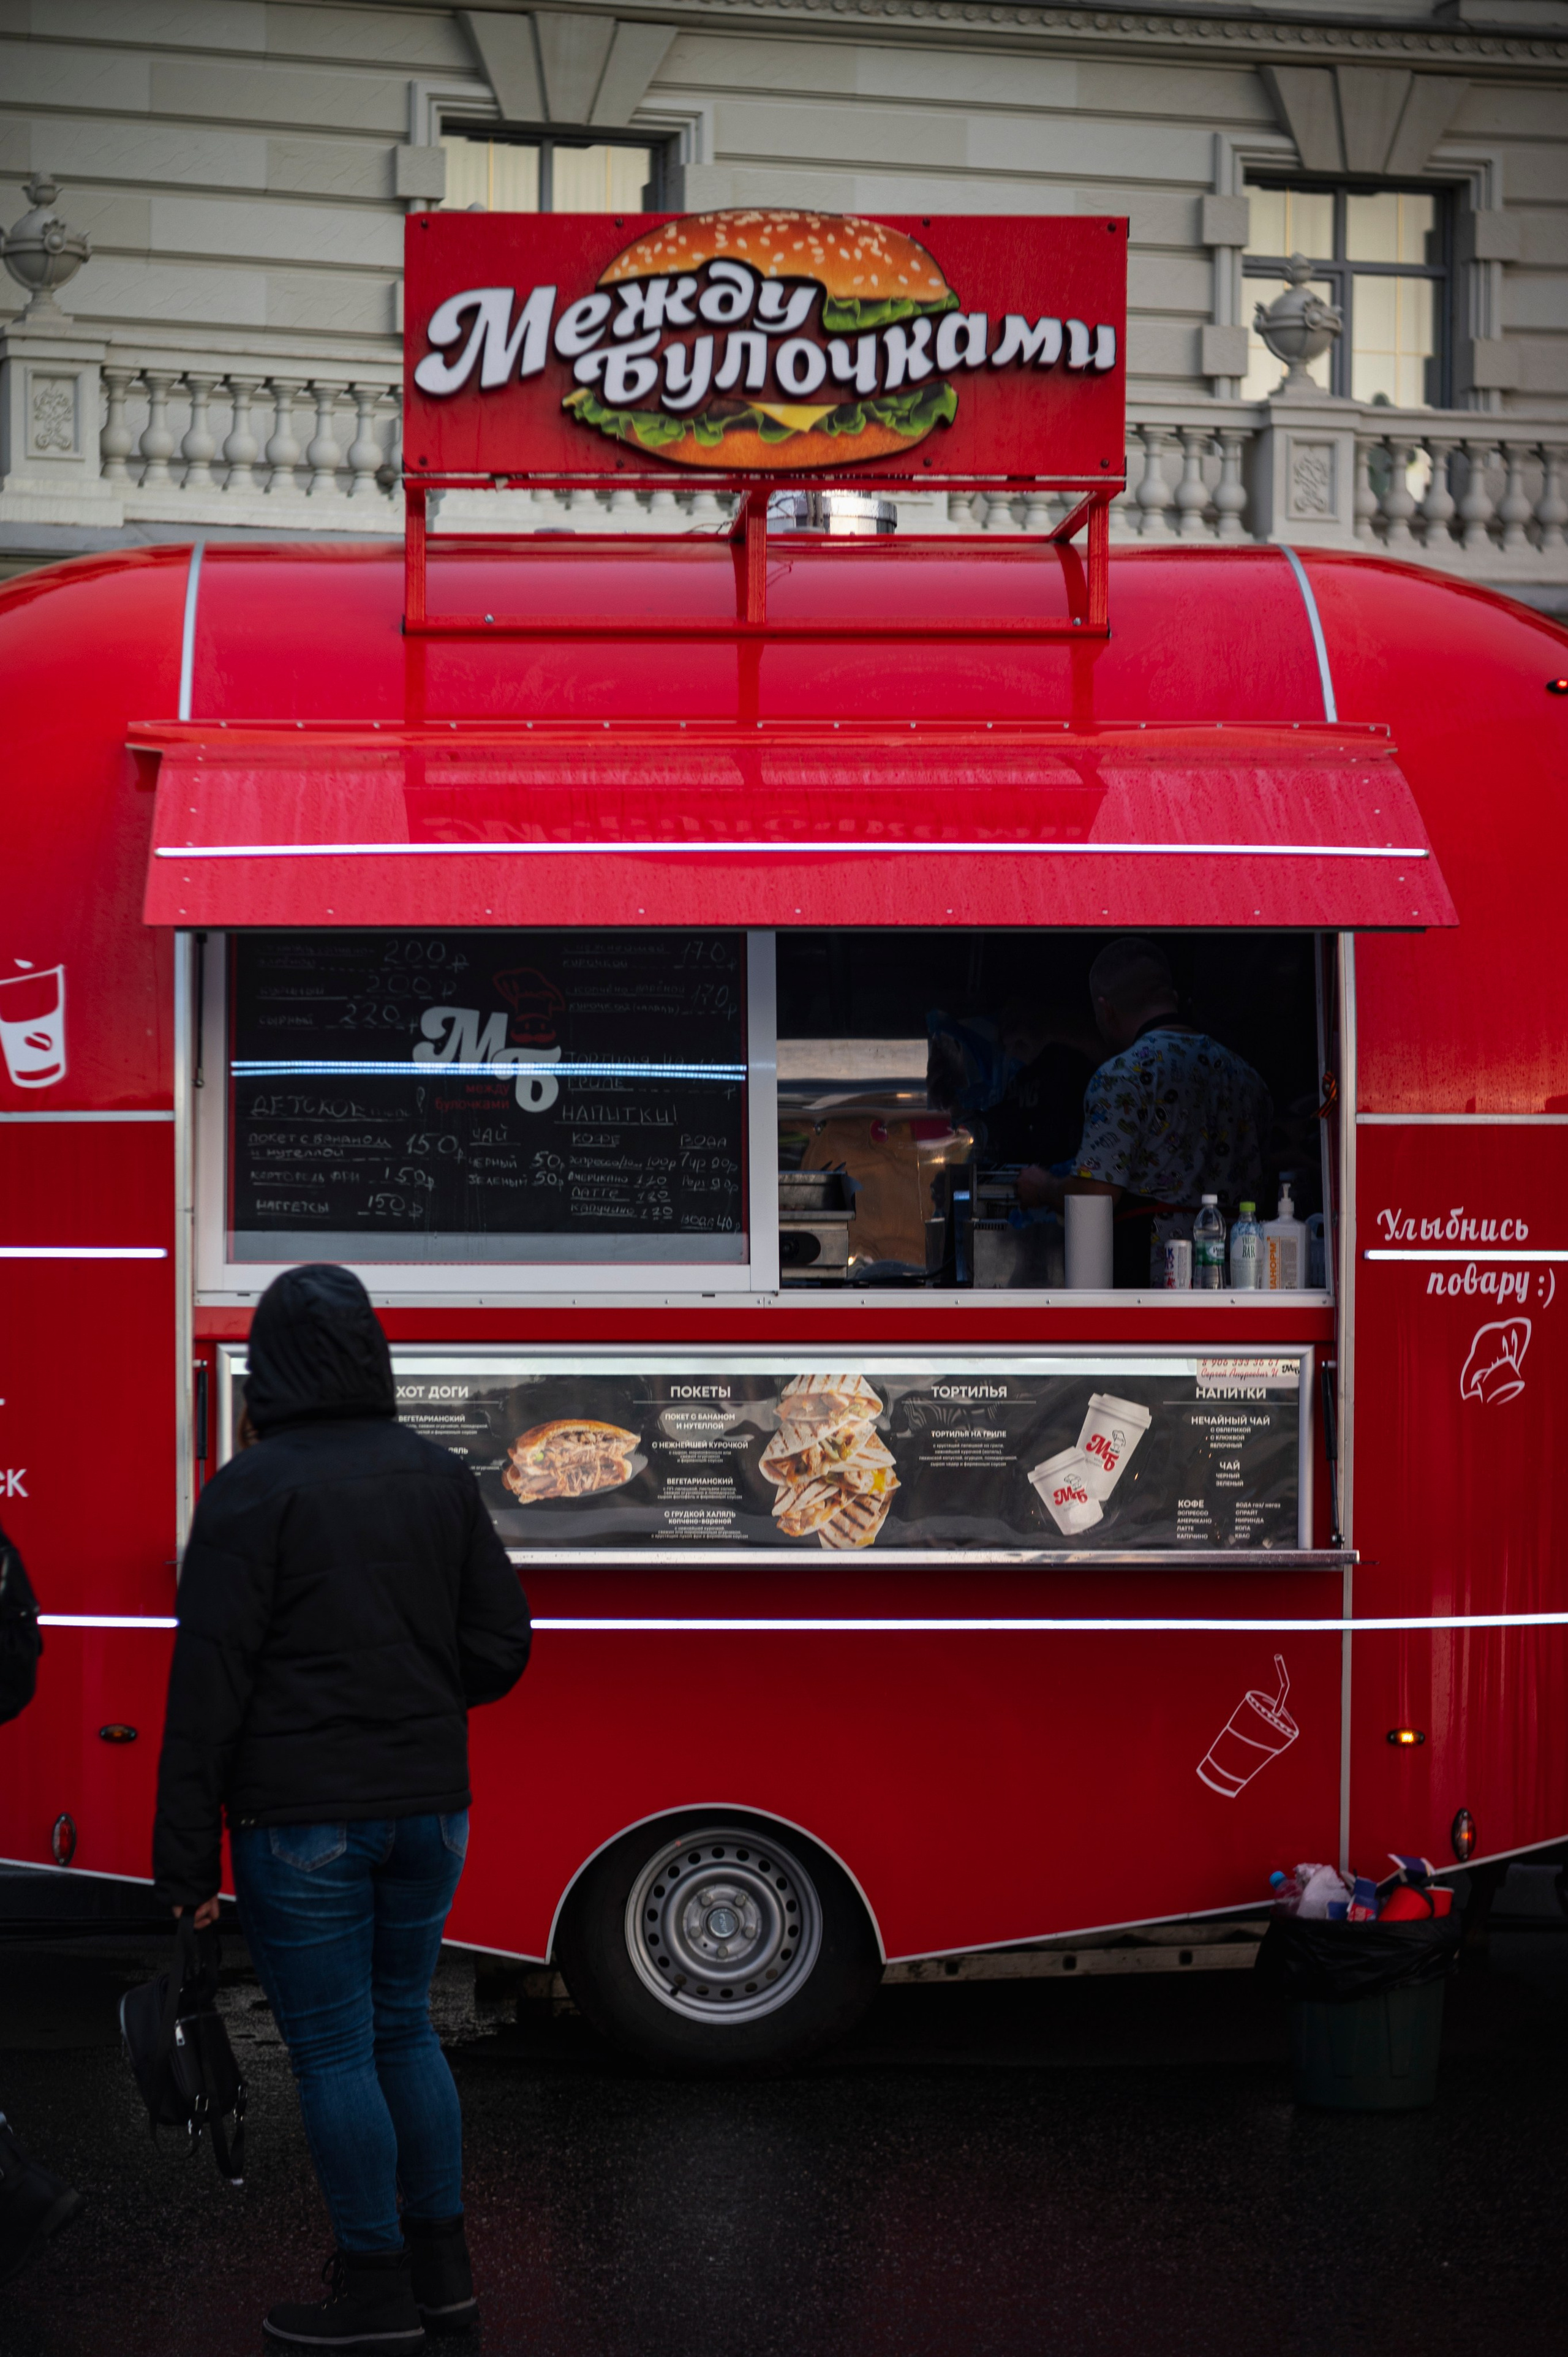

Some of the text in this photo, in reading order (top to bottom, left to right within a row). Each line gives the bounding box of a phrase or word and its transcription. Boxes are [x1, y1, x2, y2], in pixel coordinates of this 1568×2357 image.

[413, 258, 818, 398] Между
[1376, 1205, 1529, 1242] Улыбнись
[1426, 1261, 1531, 1306] повару
[396, 1386, 469, 1400] ХОТ ДОГИ
[671, 1385, 731, 1398] ПОКЕТЫ
[931, 1386, 1008, 1398] ТОРТИЛЬЯ
[1196, 1386, 1267, 1399] НАПИТКИ
[398, 1414, 466, 1423] ВЕГЕТАРИАНСКИЙ
[1191, 1414, 1271, 1426] НЕЧАЙНЫЙ ЧАЙ
[684, 1420, 725, 1430] НУТЕЛЛОЙ
[659, 1439, 707, 1449] НЕЖНЕЙШЕЙ
[709, 1440, 748, 1449] КУРОЧКОЙ
[1219, 1459, 1241, 1471] ЧАЙ
[667, 1476, 734, 1485] ВЕГЕТАРИАНСКИЙ
[1178, 1499, 1204, 1509] КОФЕ
[671, 1509, 705, 1519] ГРУДКОЙ
[706, 1510, 737, 1518] ХАЛЯЛЬ
